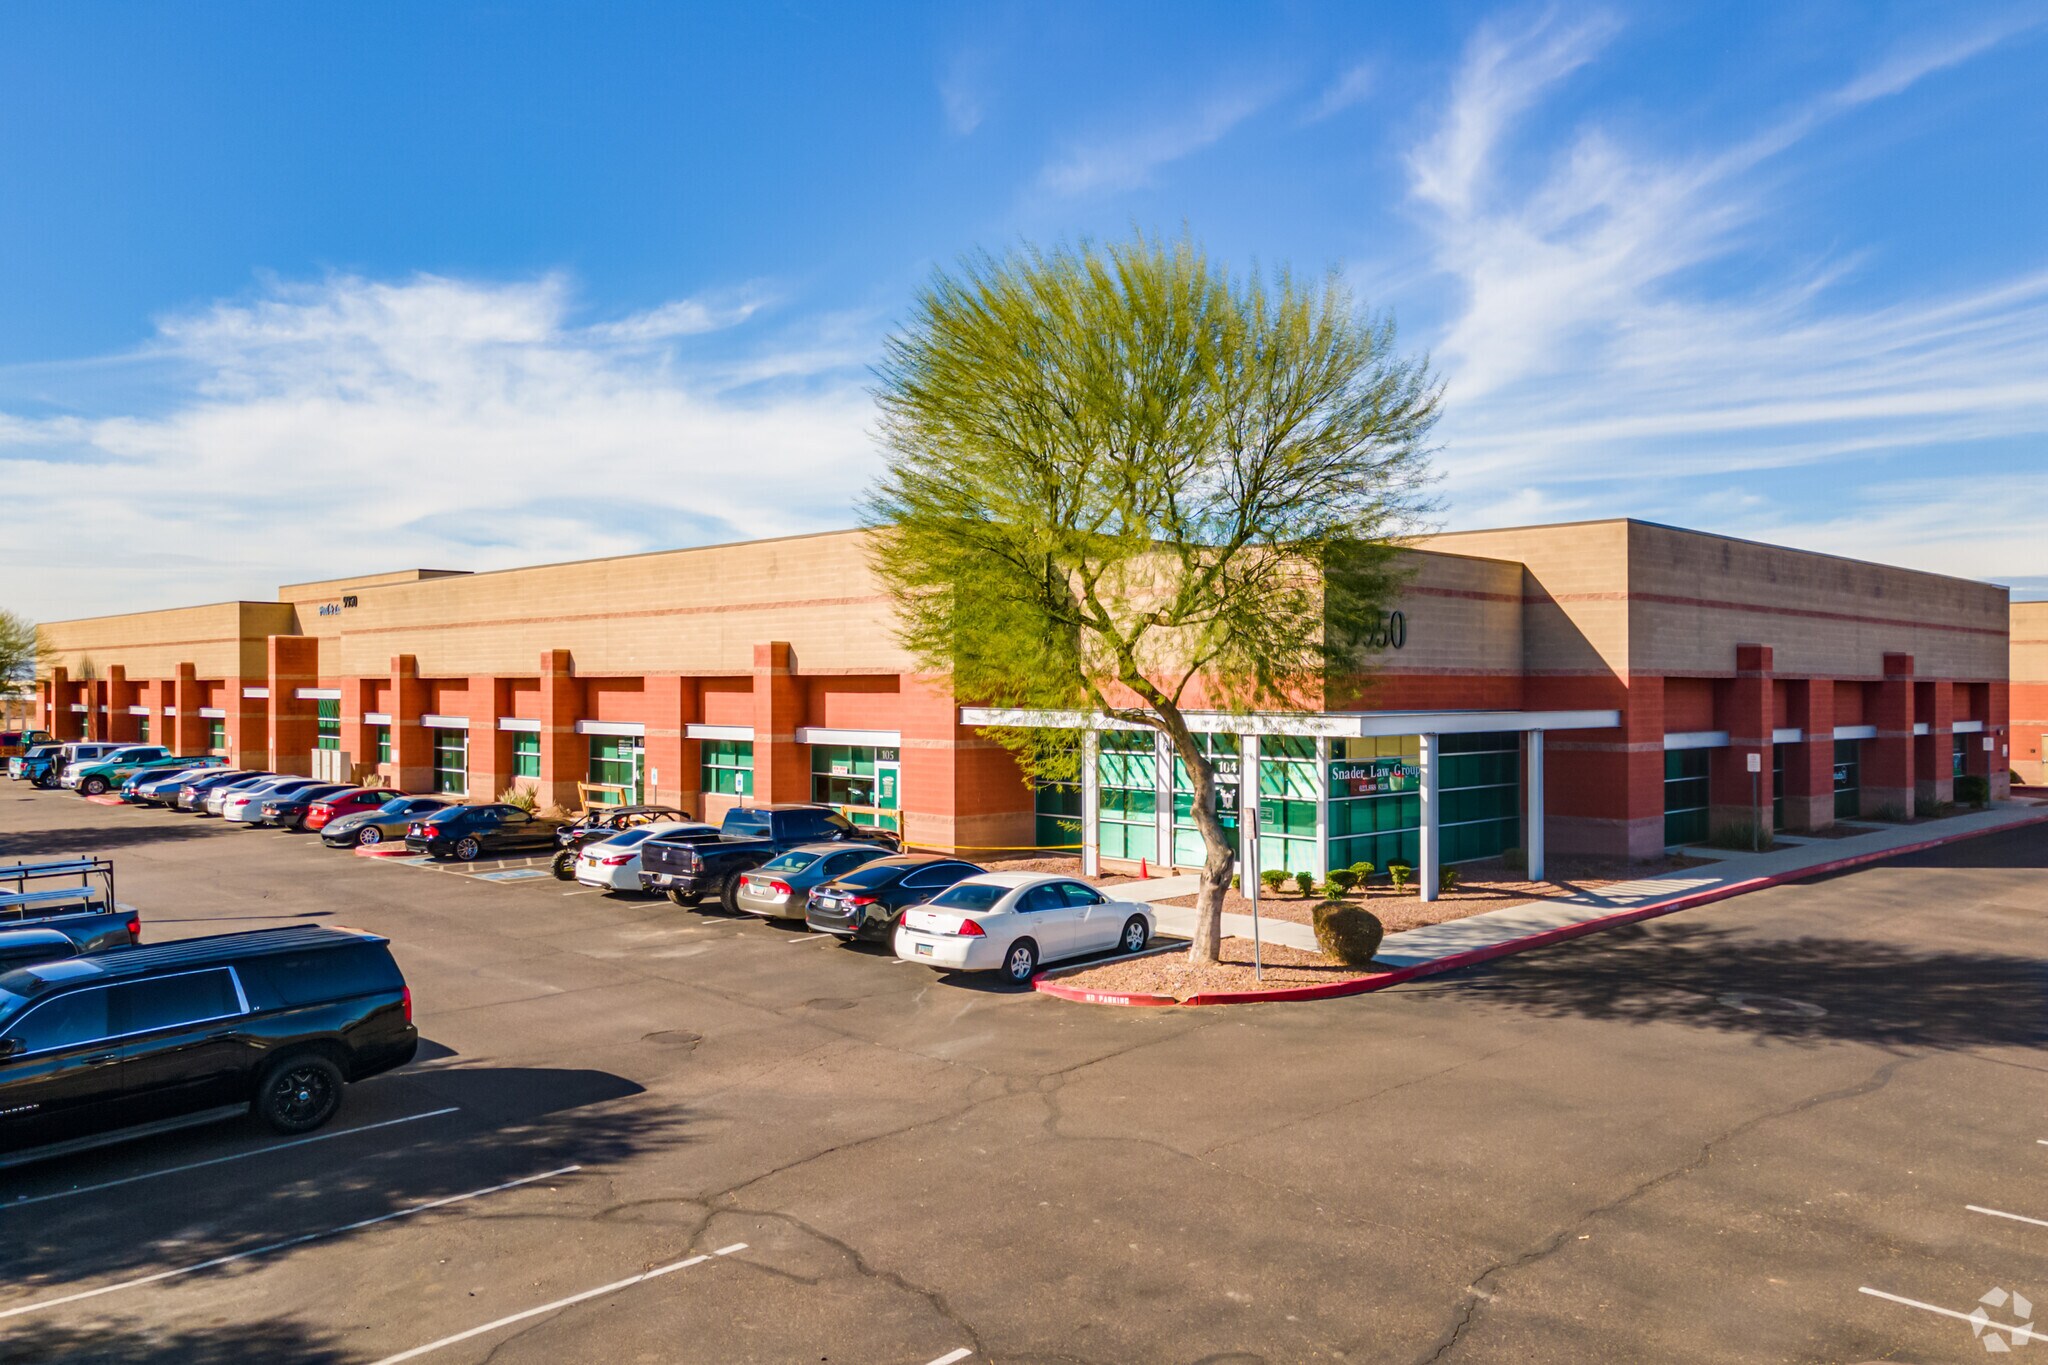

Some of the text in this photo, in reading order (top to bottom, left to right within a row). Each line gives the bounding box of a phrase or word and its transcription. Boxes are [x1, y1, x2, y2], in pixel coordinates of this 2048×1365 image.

[882, 750, 894, 760] 105
[1218, 761, 1237, 773] 104
[1332, 764, 1420, 780] Snader Law Group
[1086, 993, 1129, 1005] NO PARKING
